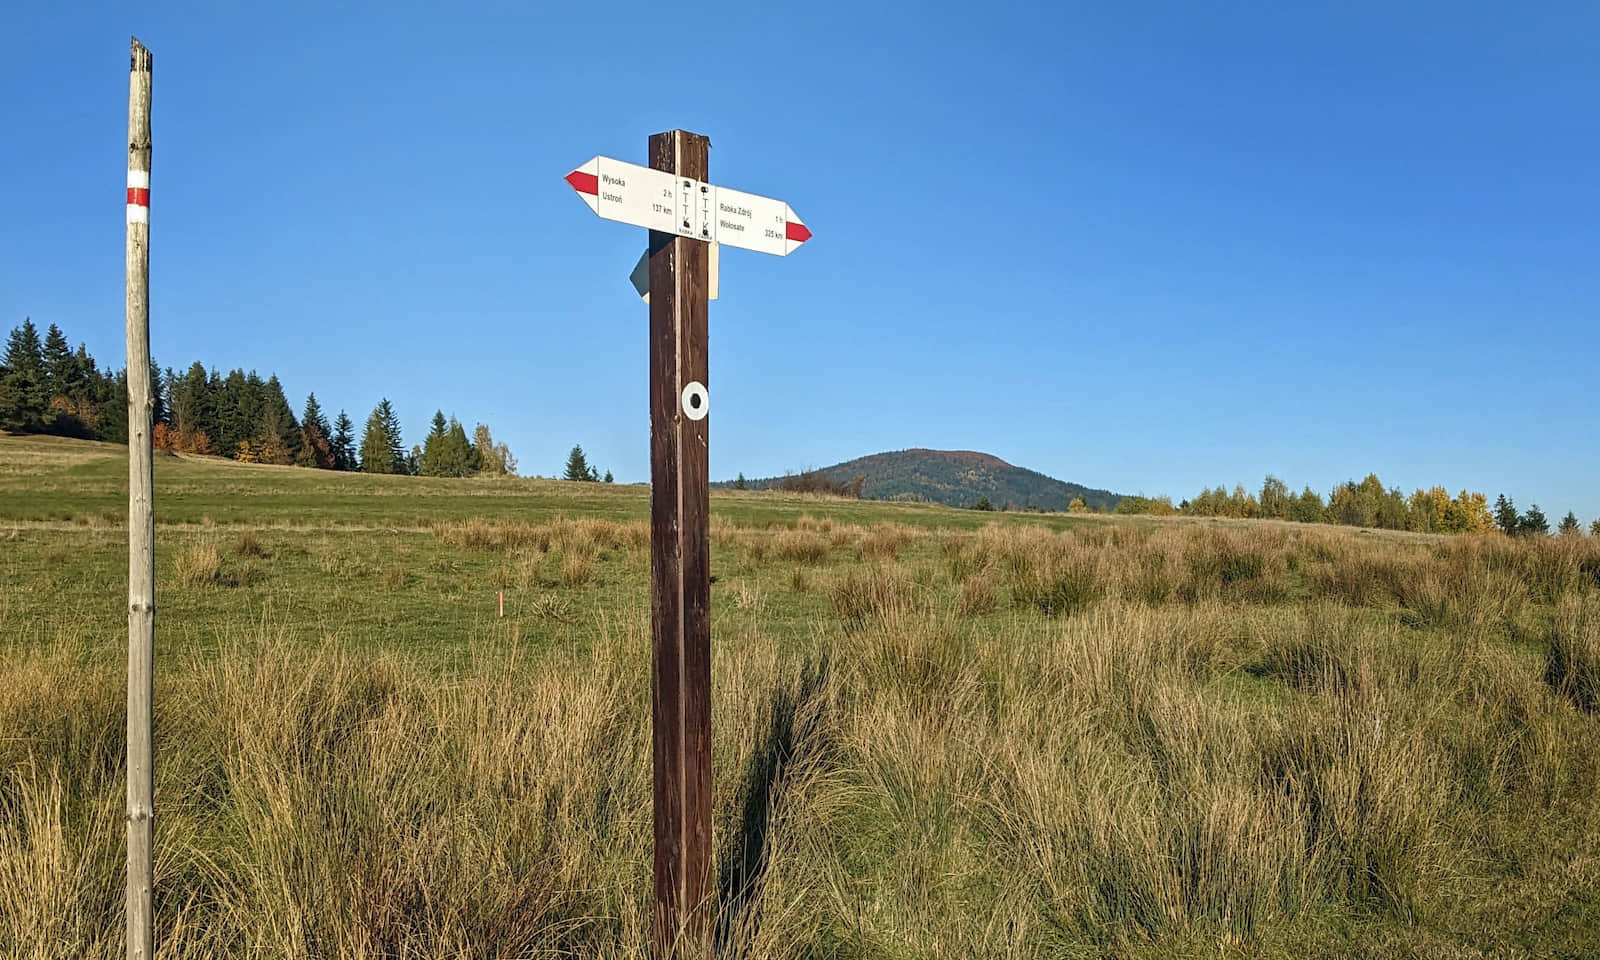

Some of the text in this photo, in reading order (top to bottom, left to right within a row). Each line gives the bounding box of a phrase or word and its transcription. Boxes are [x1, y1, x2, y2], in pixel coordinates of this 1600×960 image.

[602, 174, 625, 187] Wysoka
[602, 191, 623, 204] Ustroń
[663, 188, 673, 199] 2 h
[663, 205, 673, 216] km
[719, 202, 737, 214] Rabka
[775, 230, 784, 240] km
